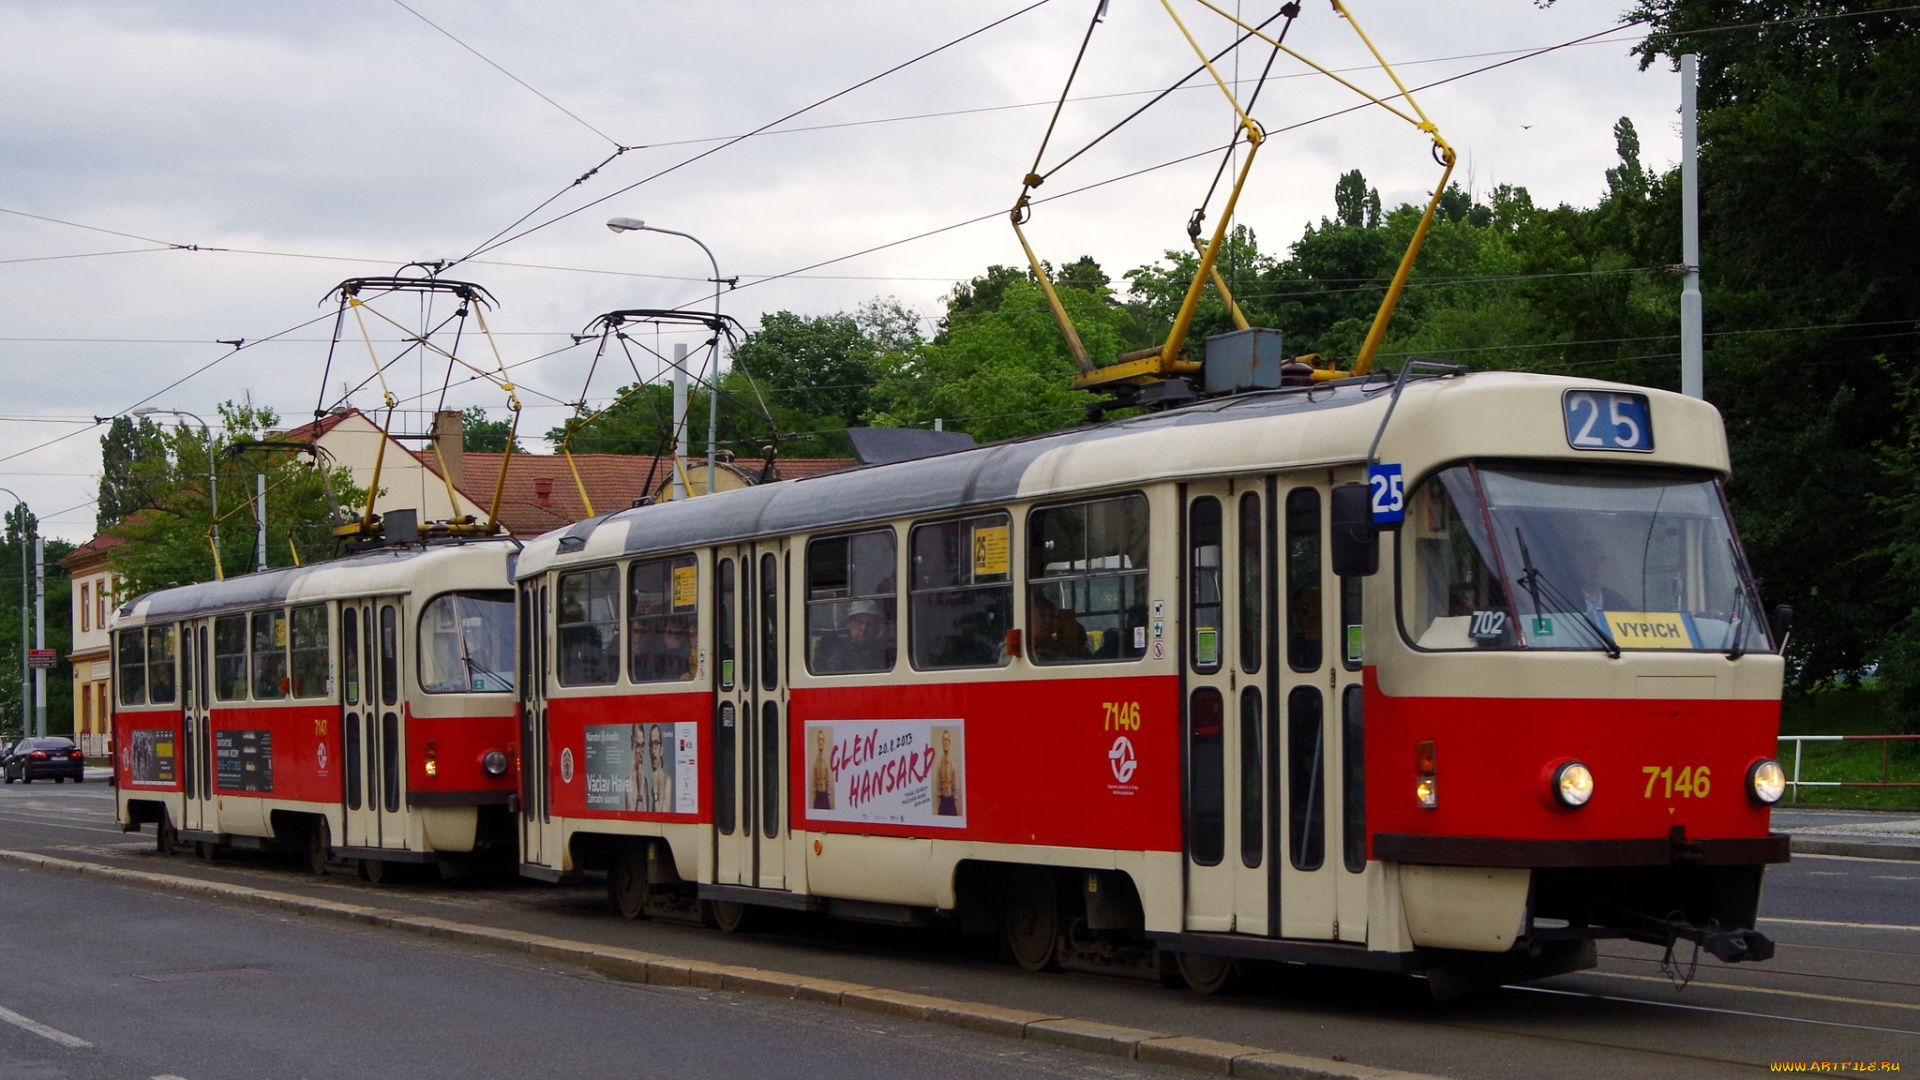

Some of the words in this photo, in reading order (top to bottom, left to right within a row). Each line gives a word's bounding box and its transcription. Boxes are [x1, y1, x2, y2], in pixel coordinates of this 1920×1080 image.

[1570, 393, 1640, 448] 25
[1369, 474, 1403, 513] 25
[1472, 610, 1506, 635] 702
[1616, 621, 1681, 638] VYPICH
[1102, 702, 1140, 731] 7146
[829, 728, 878, 783] GLEN
[586, 773, 611, 792] Václav
[611, 773, 633, 792] Havel
[848, 743, 936, 809] HANSARD
[1642, 766, 1711, 798] 7146
